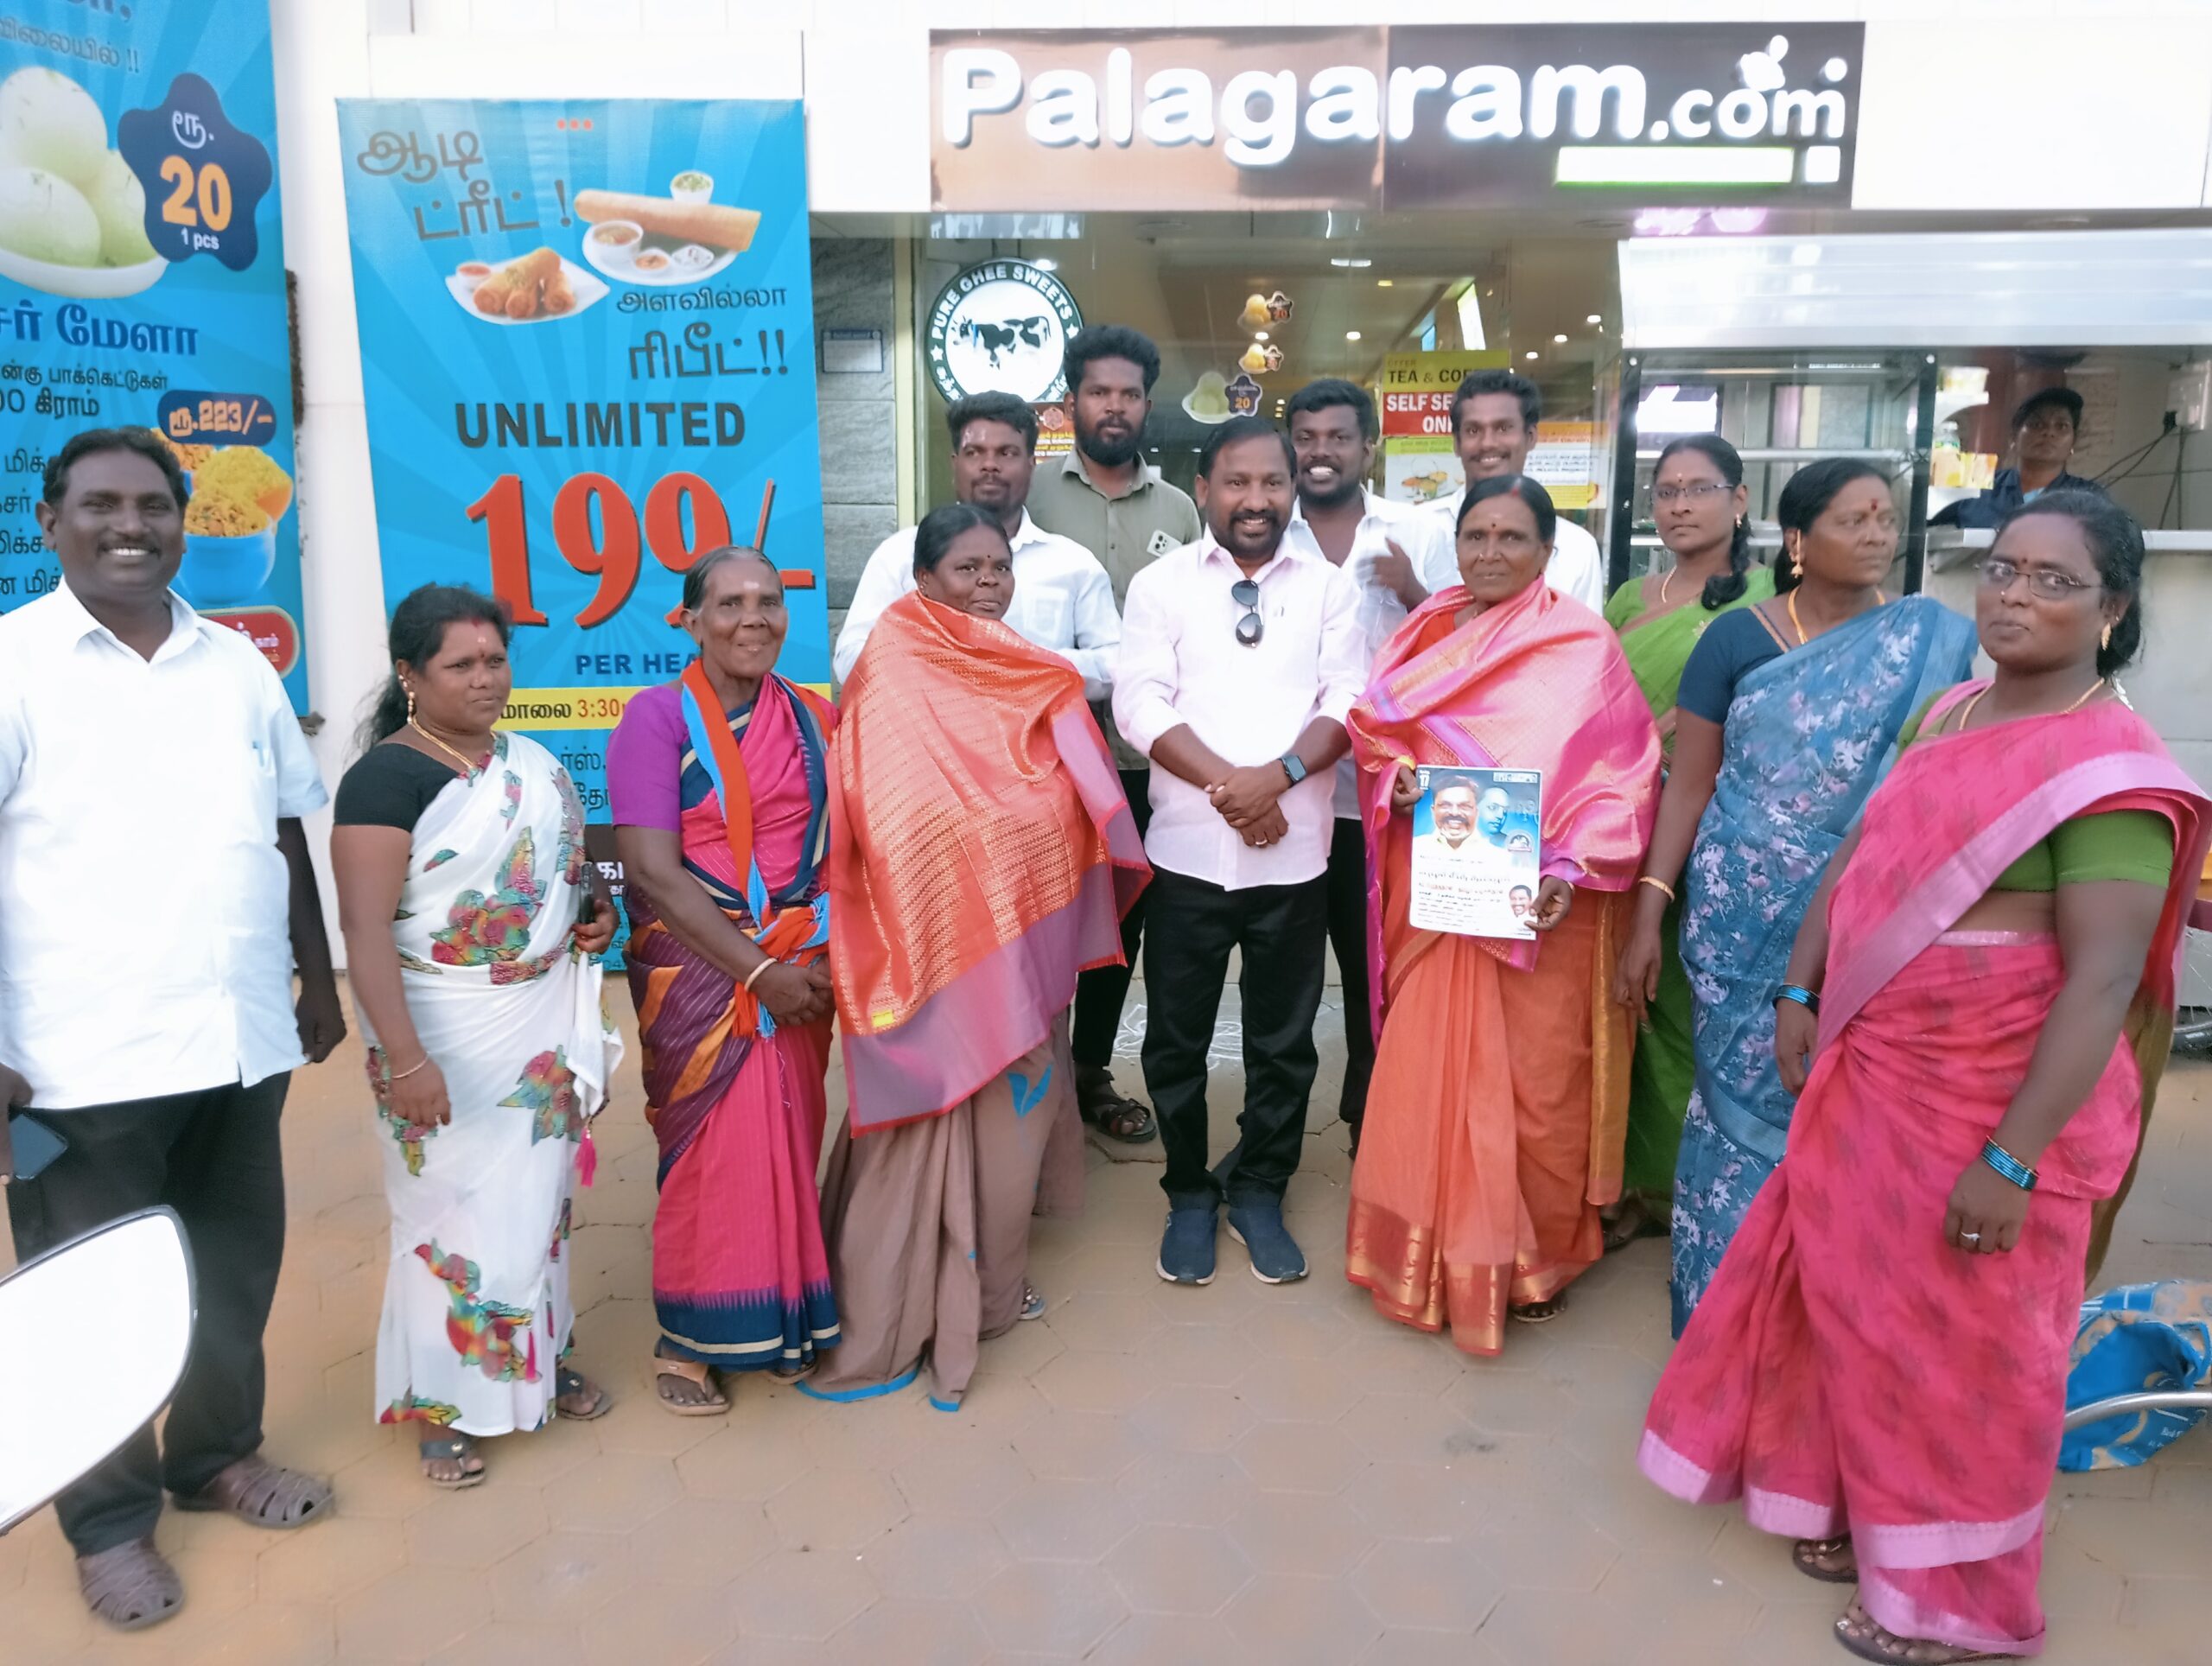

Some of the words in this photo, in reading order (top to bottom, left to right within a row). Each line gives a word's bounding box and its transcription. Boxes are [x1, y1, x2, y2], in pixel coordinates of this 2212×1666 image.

[943, 47, 1846, 167] Palagaram.com
[357, 130, 484, 185] ஆடி
[160, 155, 232, 232] 20
[181, 227, 189, 245] 1
[194, 232, 219, 251] pcs
[616, 283, 788, 313] அளவில்லா
[931, 288, 961, 340] PURE
[959, 263, 1007, 293] GHEE
[1012, 264, 1073, 321] SWEETS
[56, 303, 199, 356] மேளா
[1389, 370, 1418, 384] TEA
[1423, 373, 1433, 384] &
[0, 388, 26, 414] 0
[1235, 397, 1250, 410] 20
[1386, 393, 1428, 412] SELF
[454, 401, 747, 448] UNLIMITED
[0, 488, 32, 514] சர்
[575, 654, 632, 676] PER
[577, 698, 626, 718] 3:30
